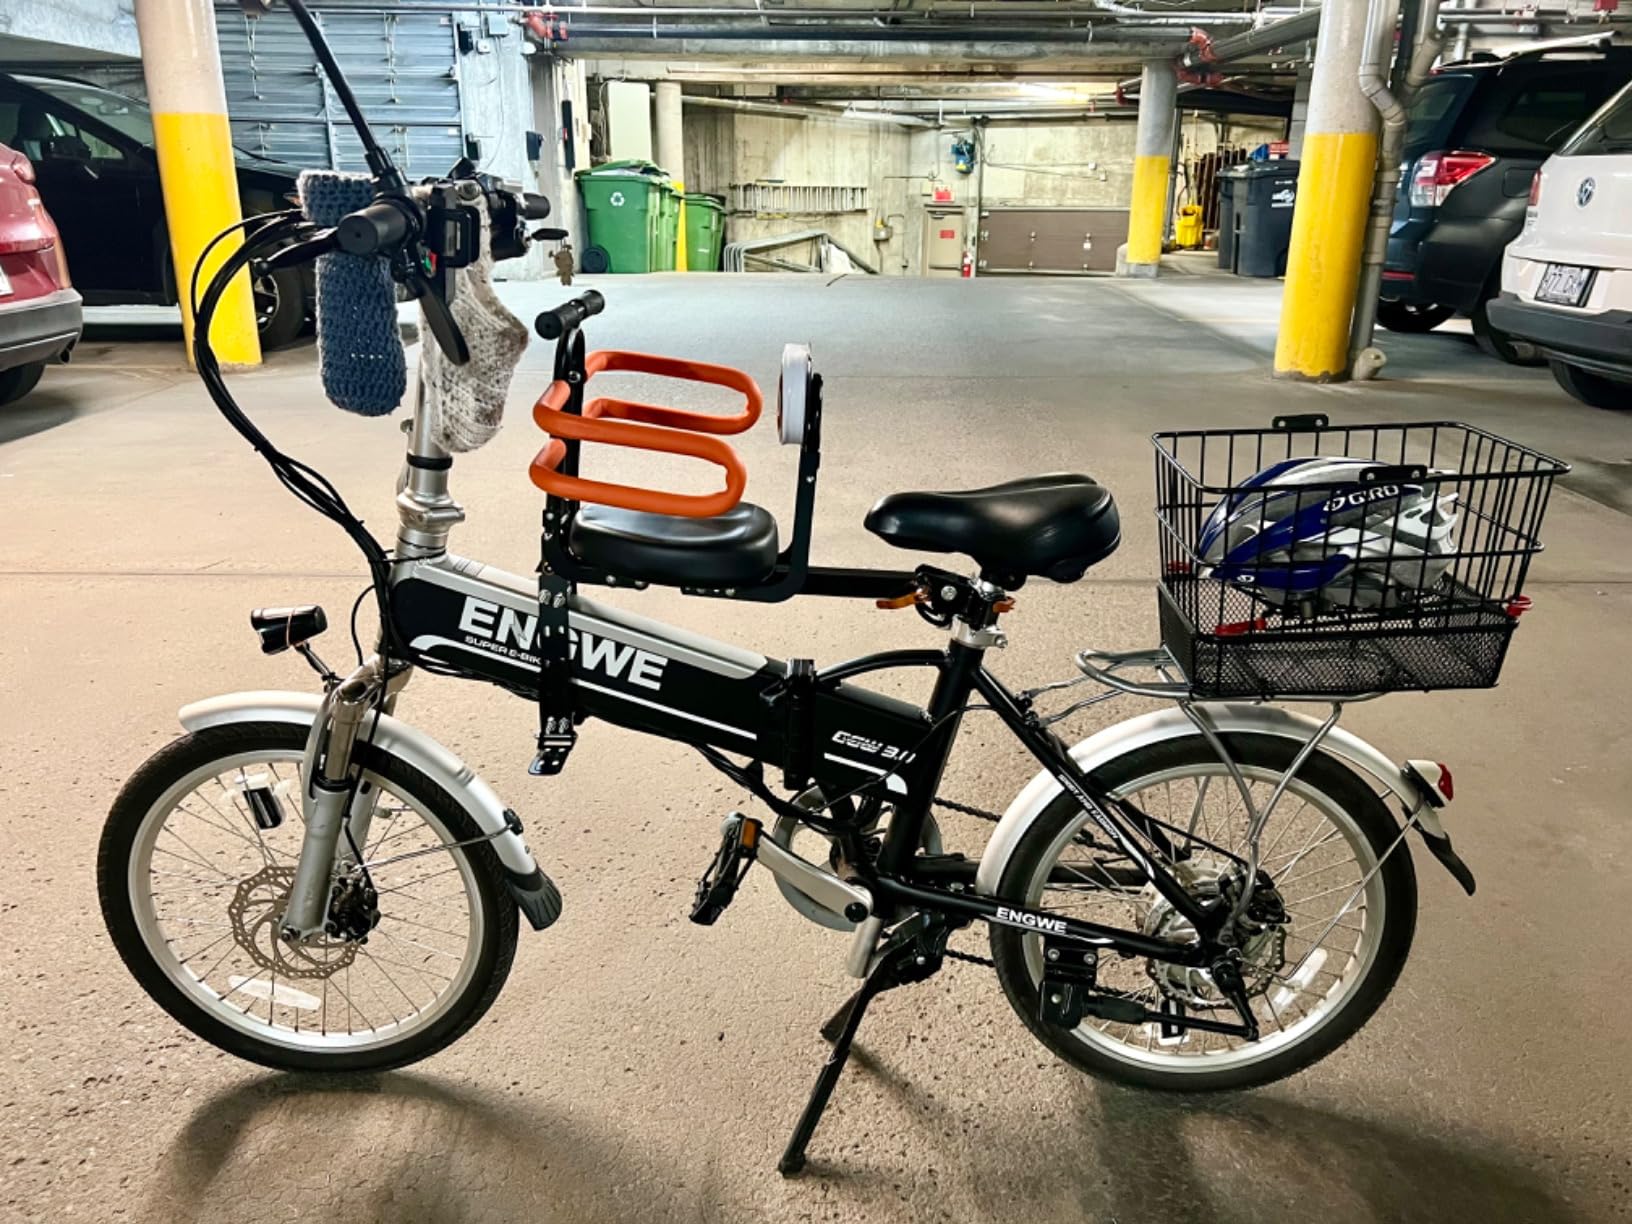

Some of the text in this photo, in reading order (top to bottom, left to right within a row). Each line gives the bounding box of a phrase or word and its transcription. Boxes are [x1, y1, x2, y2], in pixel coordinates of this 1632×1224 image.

[465, 635, 542, 665] SUPER E-BIK
[996, 906, 1068, 934] ENGWE
